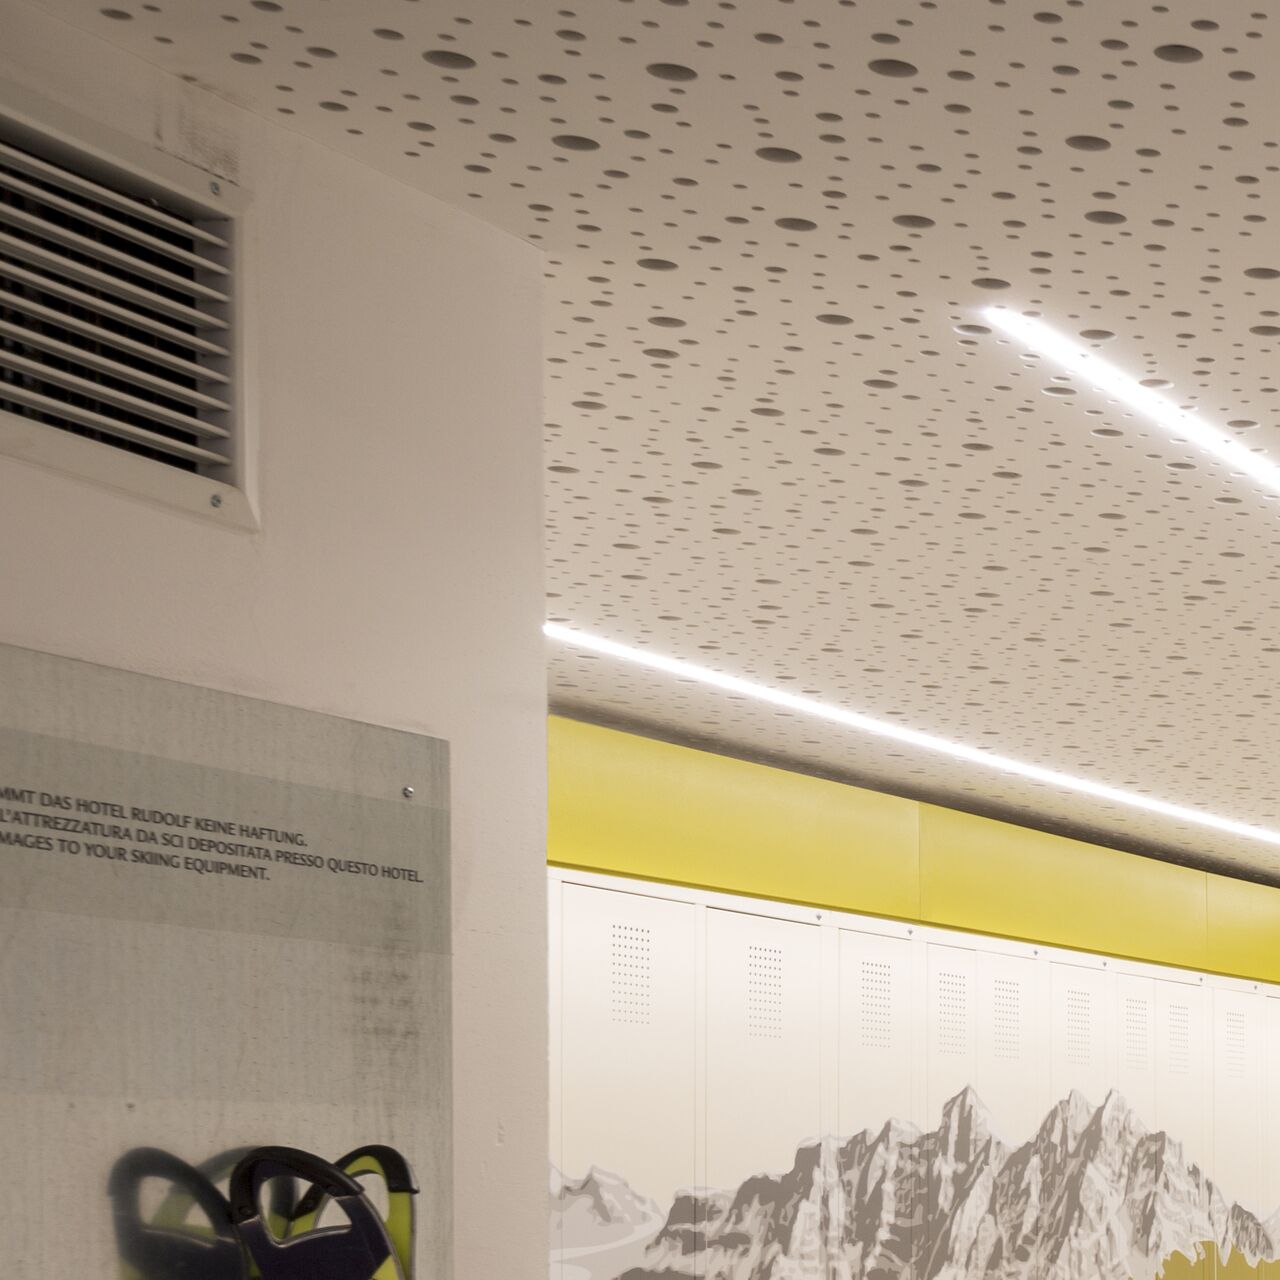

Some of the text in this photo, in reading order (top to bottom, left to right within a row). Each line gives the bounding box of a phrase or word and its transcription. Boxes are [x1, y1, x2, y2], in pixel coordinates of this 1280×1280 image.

[39, 792, 73, 810] DAS
[75, 798, 128, 819] HOTEL
[131, 806, 193, 828] RUDOLF
[194, 817, 236, 836] KEINE
[238, 824, 308, 847] HAFTUNG.
[57, 838, 80, 855] TO
[84, 842, 128, 862] YOUR
[130, 849, 181, 869] SKIING
[183, 856, 271, 881] EQUIPMENT.
[135, 828, 159, 845] DA
[160, 832, 184, 849] SCI
[187, 836, 272, 861] DEPOSITATA
[274, 849, 325, 869] PRESSO
[327, 857, 379, 876] QUESTO
